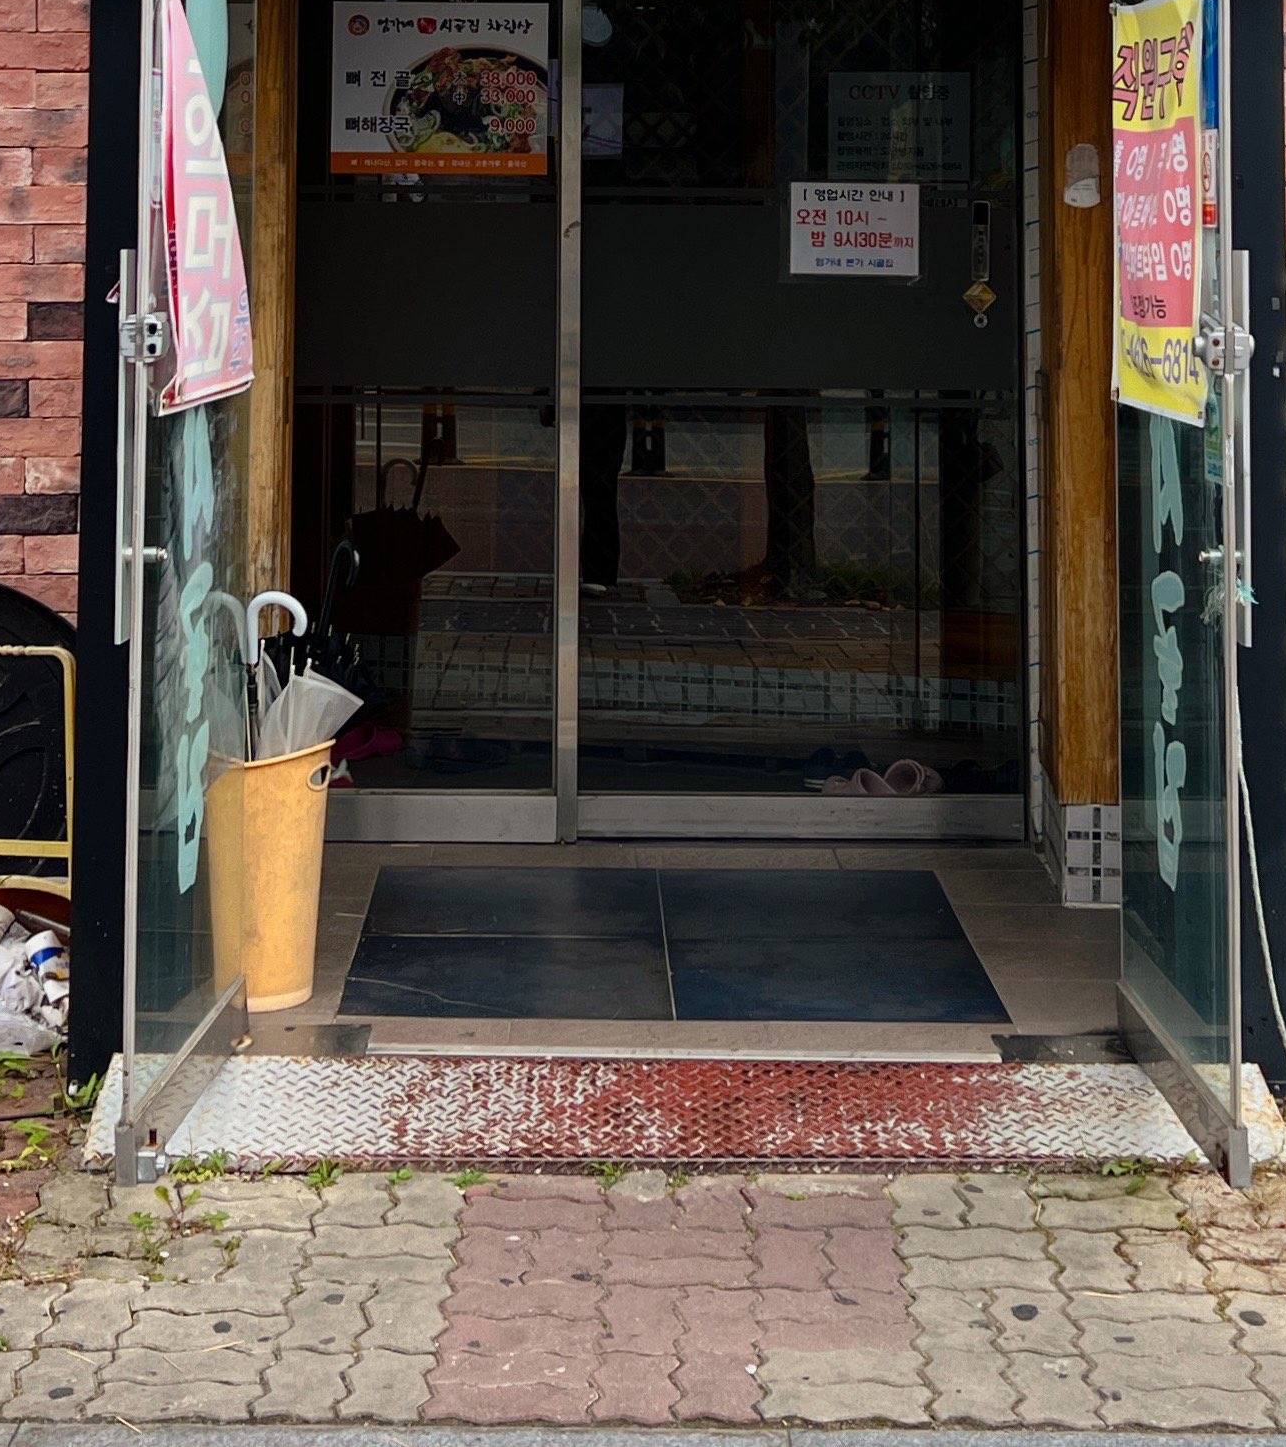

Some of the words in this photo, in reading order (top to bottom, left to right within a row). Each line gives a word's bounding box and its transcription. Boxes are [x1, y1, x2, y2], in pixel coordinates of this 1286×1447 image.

[481, 70, 537, 87] 38,000
[481, 89, 536, 105] 33,000
[345, 115, 411, 134] 뼈해장국
[490, 117, 536, 134] 9,000
[815, 188, 863, 202] 영업시간
[870, 189, 894, 202] 안내
[796, 208, 827, 226] 오전
[836, 209, 869, 226] 10시
[810, 231, 826, 248] 밤
